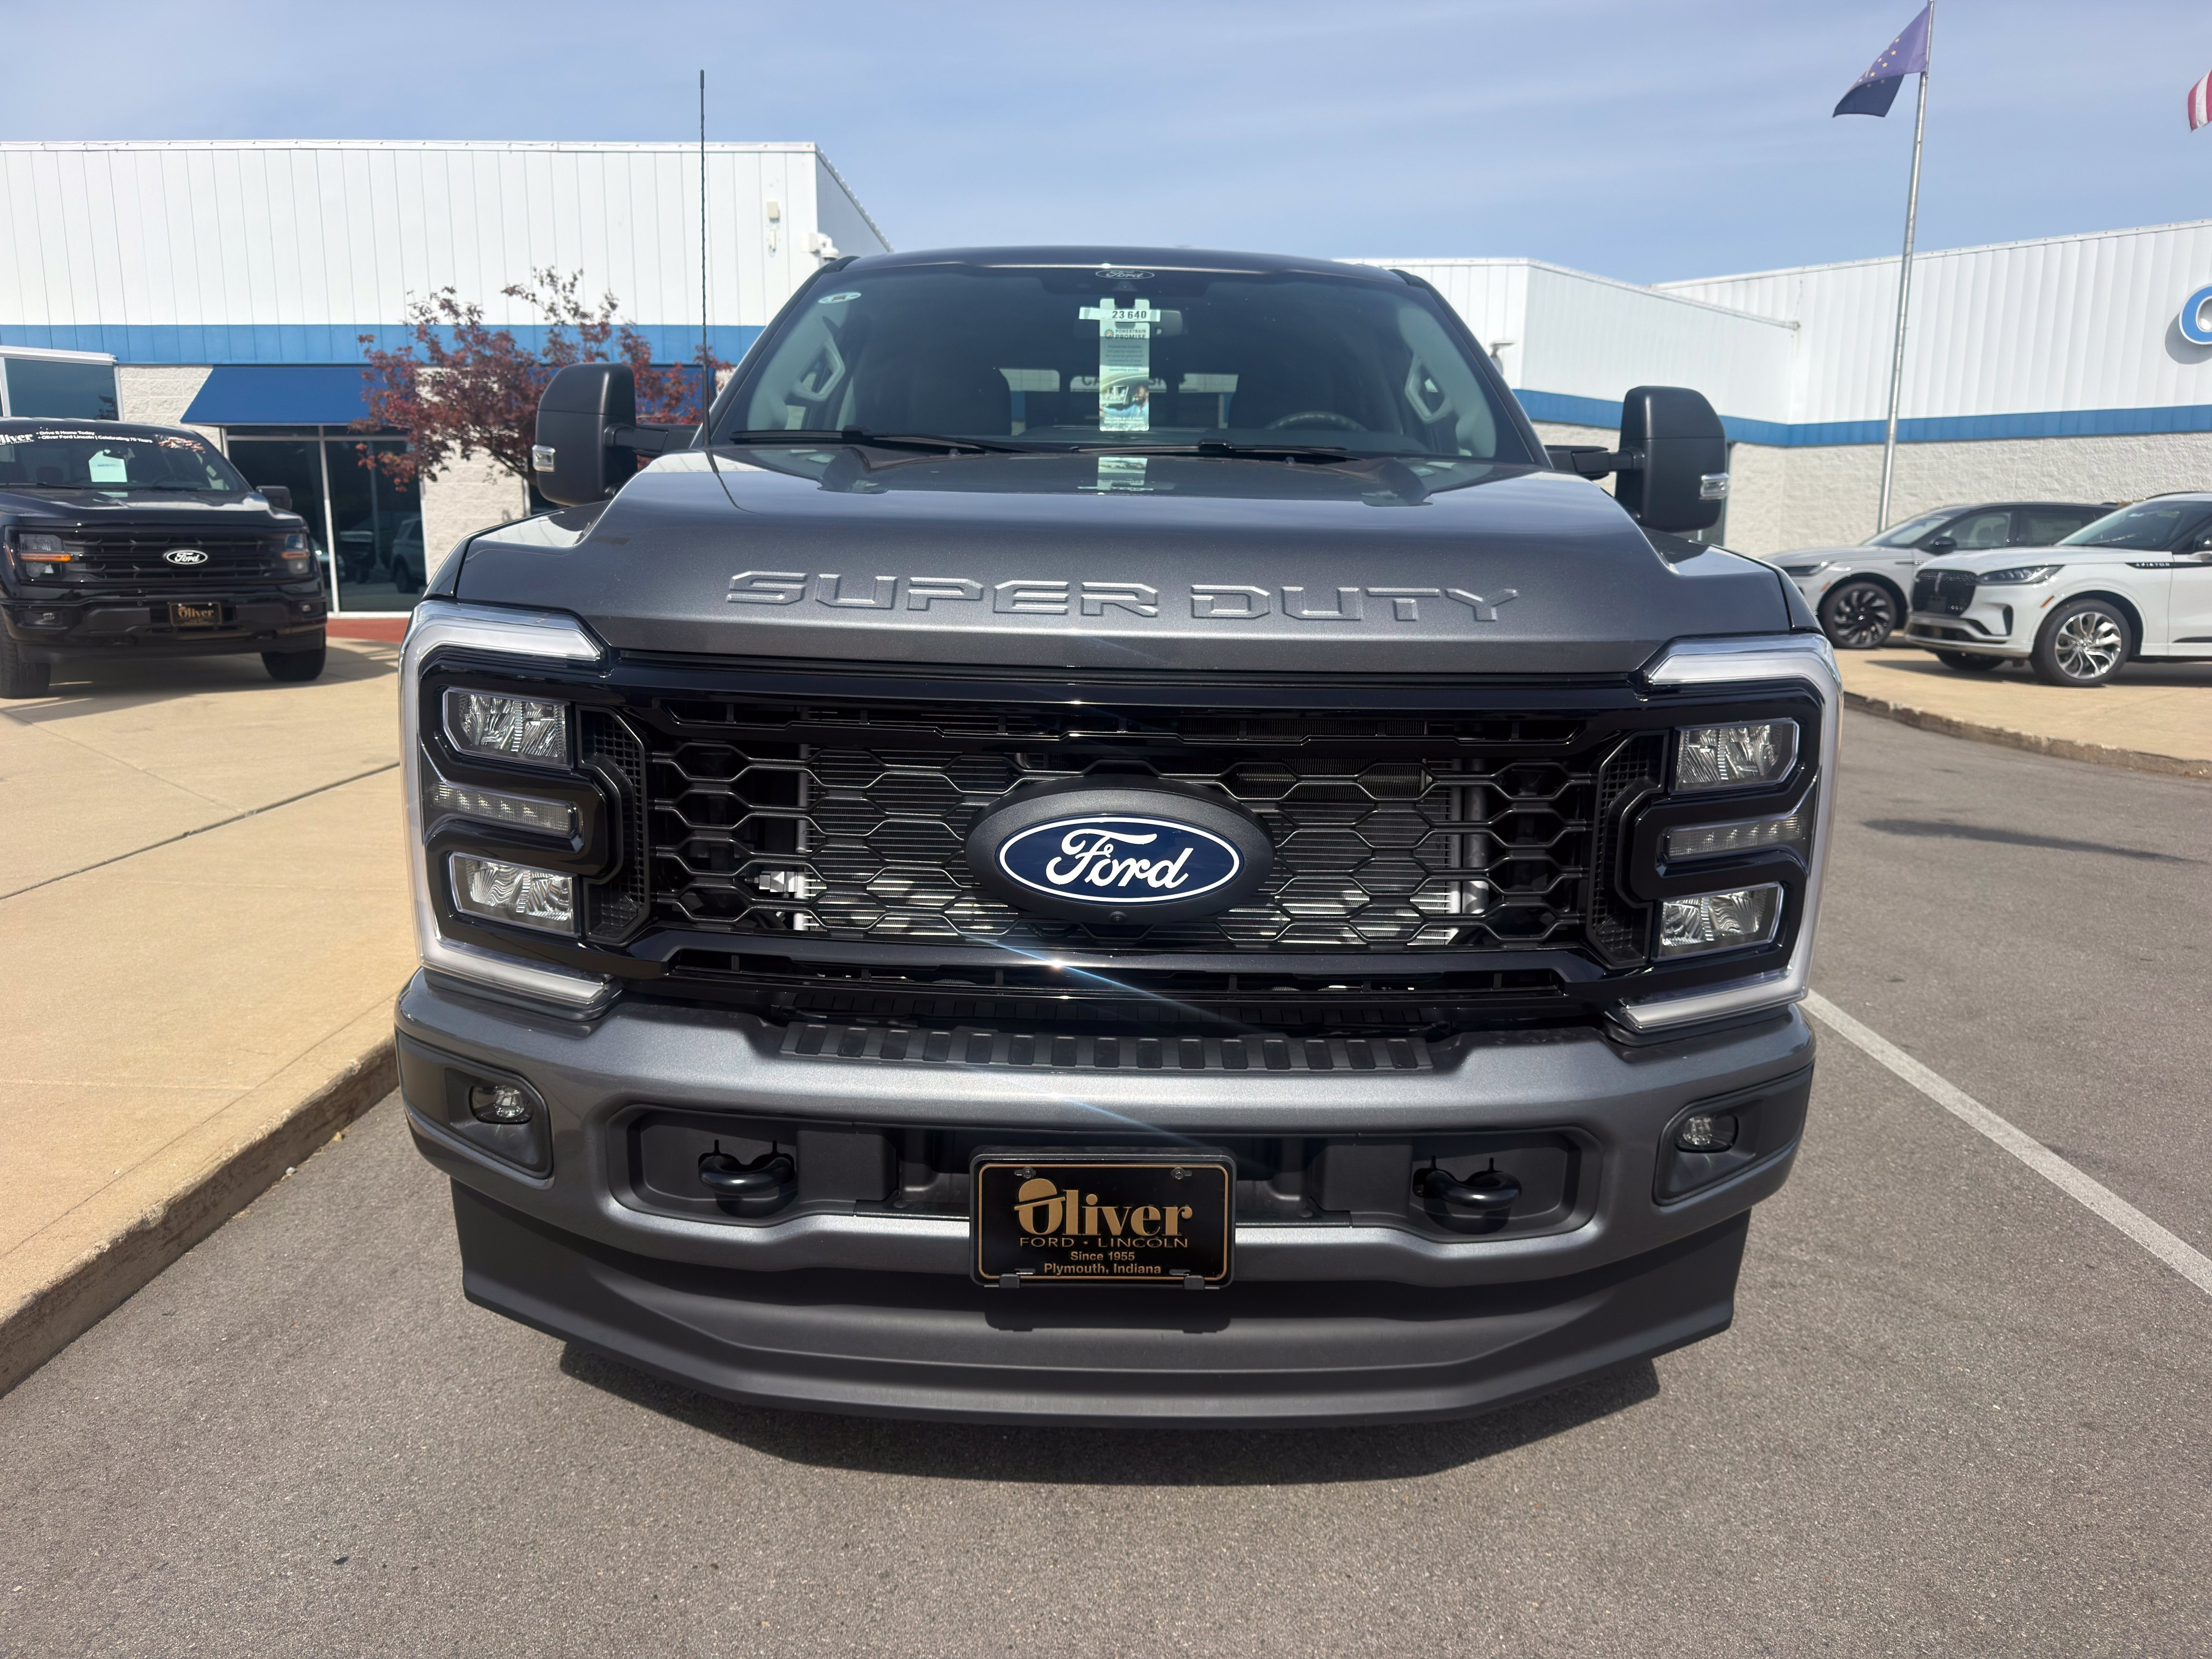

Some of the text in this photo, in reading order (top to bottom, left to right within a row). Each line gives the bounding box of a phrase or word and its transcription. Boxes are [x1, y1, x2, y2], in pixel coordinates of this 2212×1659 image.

[0, 434, 33, 443] liver
[174, 552, 200, 562] Ford
[726, 571, 1519, 621] SUPER DUTY
[178, 606, 214, 618] Oliver
[1046, 828, 1194, 889] Ford
[1014, 1178, 1193, 1237] Oliver
[1020, 1237, 1188, 1248] FORD LINCOLN
[1070, 1251, 1135, 1261] Since 1955
[1044, 1263, 1161, 1276] Plymouth, Indiana
